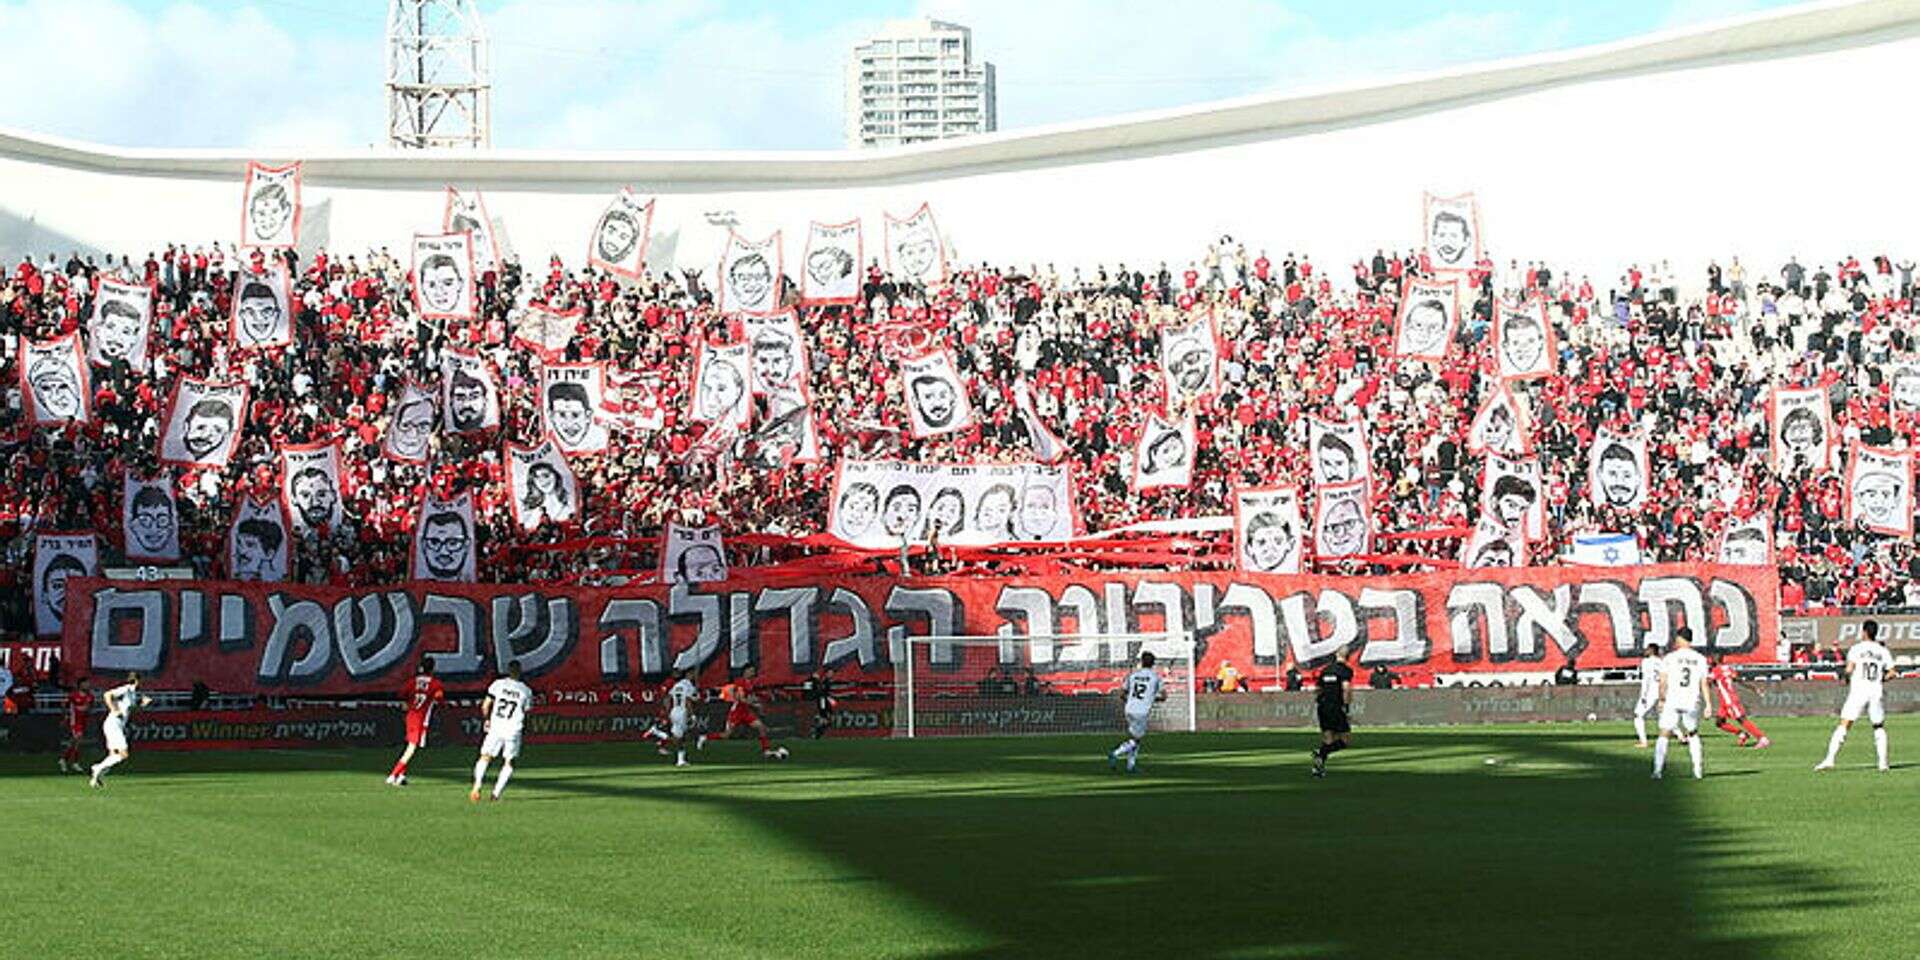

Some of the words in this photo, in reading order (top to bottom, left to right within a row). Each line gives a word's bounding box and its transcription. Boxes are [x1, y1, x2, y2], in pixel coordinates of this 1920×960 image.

[996, 580, 1431, 669] בטריבונה
[1445, 577, 1757, 662] נתראה
[91, 587, 580, 683] שבשמיים
[600, 583, 964, 681] הגדולה
[1680, 667, 1691, 687] 3
[1862, 662, 1878, 681] 10
[1132, 683, 1147, 700] 12
[496, 699, 517, 719] 27
[192, 719, 272, 740] Winner
[274, 719, 377, 740] אפליקציית
